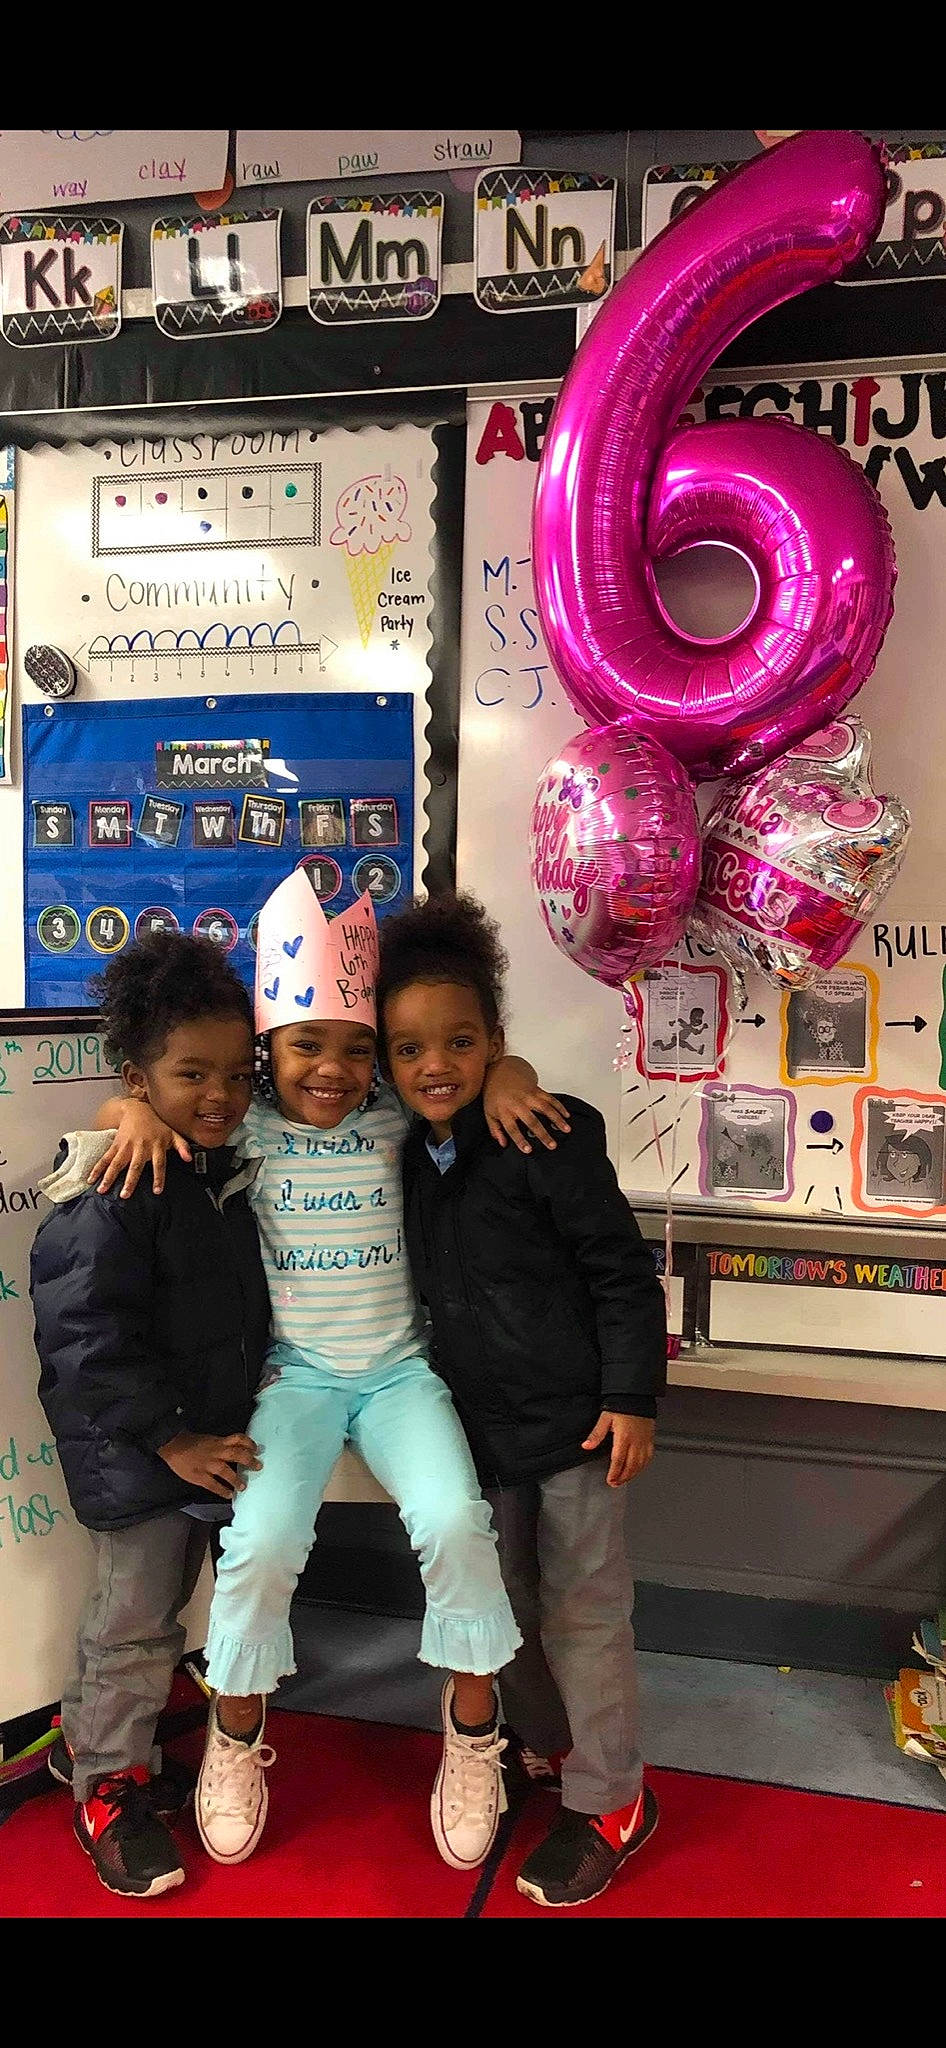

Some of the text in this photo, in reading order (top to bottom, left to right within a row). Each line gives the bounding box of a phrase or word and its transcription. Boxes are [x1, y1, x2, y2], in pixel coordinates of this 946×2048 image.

[434, 139, 493, 161] straw
[139, 159, 187, 181] clay
[242, 160, 282, 180] raw
[339, 153, 379, 176] paw
[53, 180, 88, 198] way
[505, 204, 586, 270] Nn
[320, 219, 430, 285] Mm
[23, 247, 92, 310] Kk
[390, 567, 412, 584] Ice
[106, 564, 297, 612] Community
[377, 592, 426, 608] Cream
[380, 616, 414, 634] Party
[153, 672, 160, 682] 3
[176, 671, 183, 680] 4
[200, 669, 206, 678] 5
[225, 669, 231, 677] 6
[318, 665, 327, 673] 10
[172, 754, 253, 777] March
[40, 805, 67, 815] Sunday
[94, 805, 126, 815] Monday
[148, 799, 181, 814] Tuesday
[195, 805, 231, 814] Wednesday
[248, 799, 283, 813] Thursday
[308, 803, 336, 813] Friday
[354, 803, 394, 812] Saturday
[46, 816, 59, 839] S
[96, 816, 121, 839] M
[155, 812, 168, 835] T
[201, 816, 226, 839] W
[250, 811, 277, 838] Th
[316, 814, 329, 837] F
[368, 814, 383, 837] S
[313, 868, 322, 891] 1
[368, 868, 384, 891] 2
[52, 918, 66, 939] 3
[99, 919, 114, 940] 4
[208, 921, 224, 943] 6
[340, 951, 369, 976] 6th
[34, 1035, 101, 1079] 2019
[277, 1129, 375, 1156] I wish
[274, 1178, 387, 1212] I was a
[273, 1228, 403, 1272] unicorn!
[706, 1250, 848, 1286] TOMORROW'S
[853, 1263, 946, 1293] WEATHE
